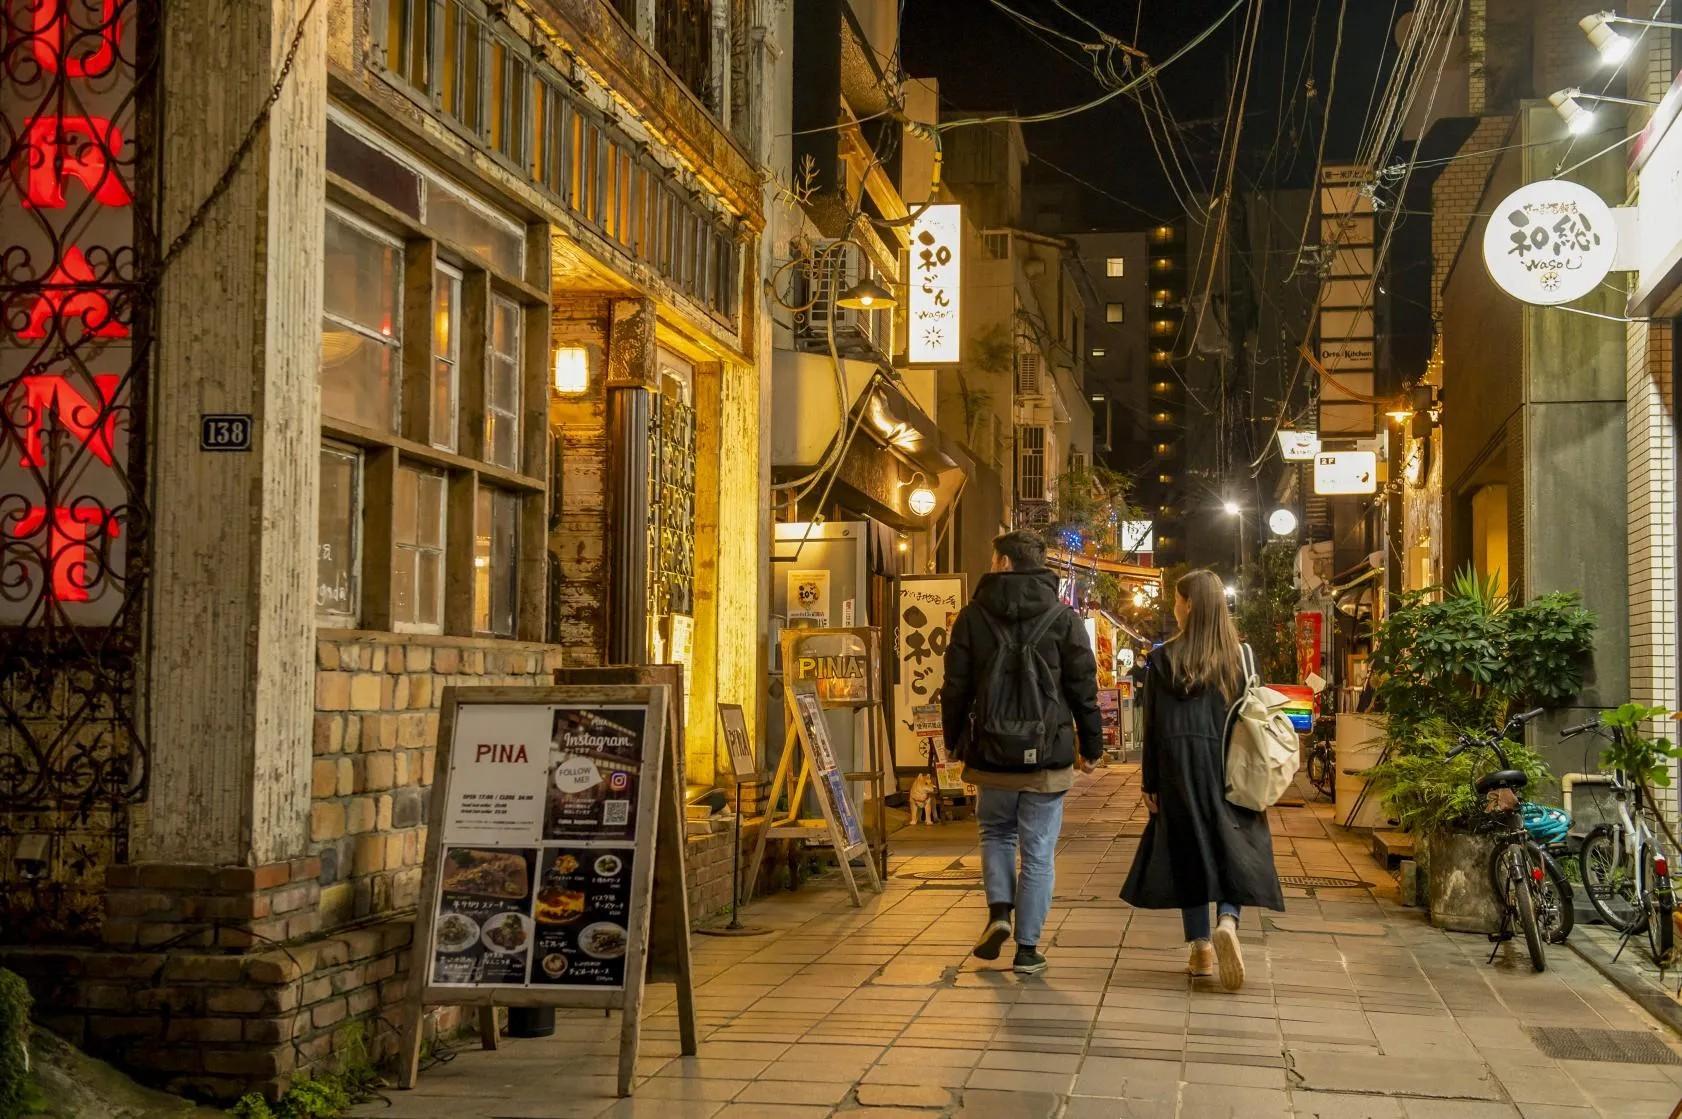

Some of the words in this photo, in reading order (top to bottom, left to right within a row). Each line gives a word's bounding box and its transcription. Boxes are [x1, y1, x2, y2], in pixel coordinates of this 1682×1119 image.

[1507, 209, 1600, 257] 和総
[917, 230, 951, 307] 和ごん
[207, 421, 244, 444] 138
[1320, 457, 1336, 466] 2F
[798, 656, 863, 680] PINA
[475, 743, 529, 764] PINA
[560, 767, 592, 777] FOLLOW
